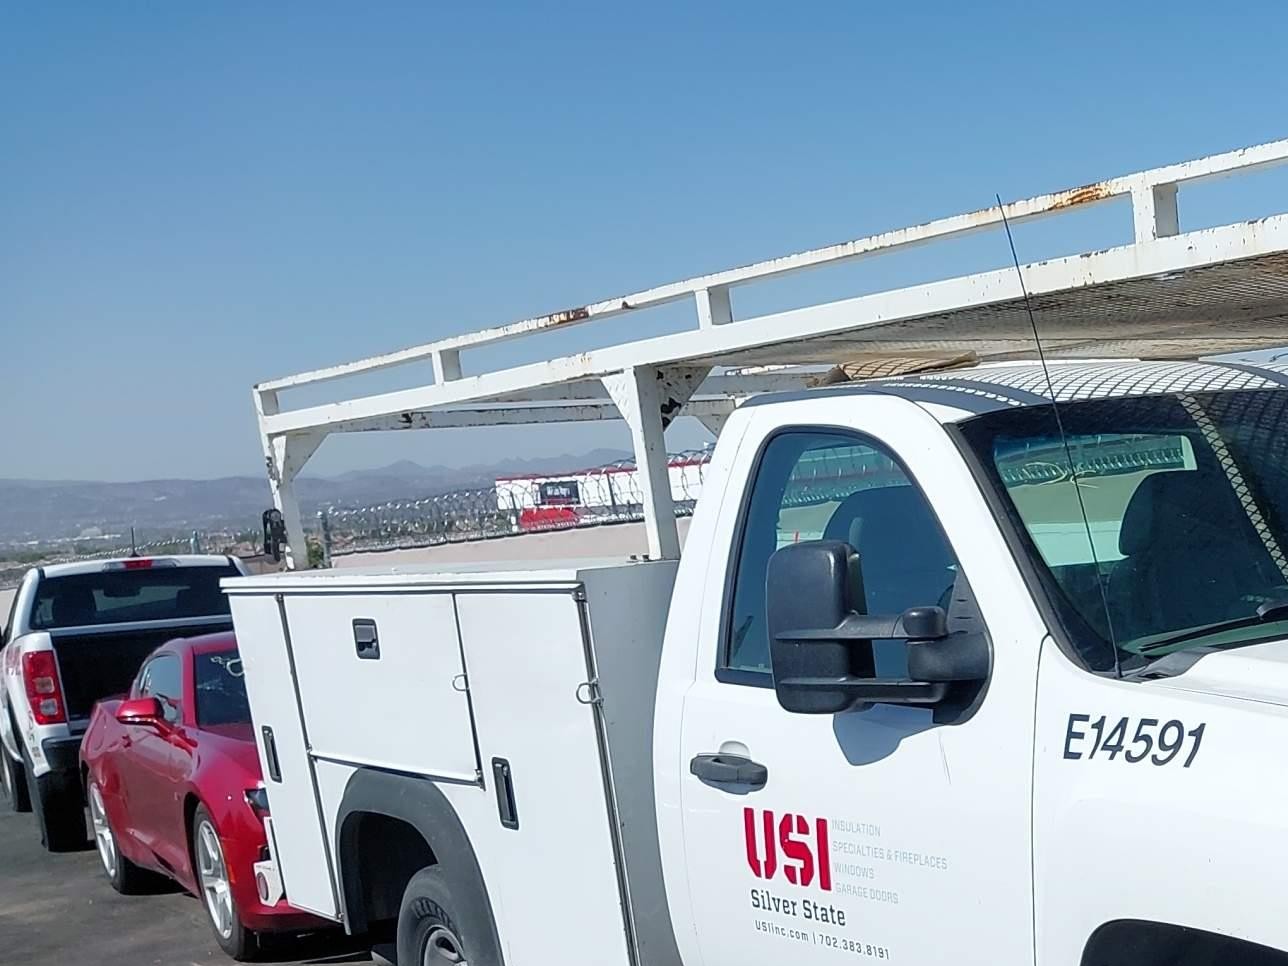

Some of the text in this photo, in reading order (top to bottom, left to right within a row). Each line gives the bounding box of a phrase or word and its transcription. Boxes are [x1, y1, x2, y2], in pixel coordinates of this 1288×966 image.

[1063, 713, 1206, 768] E14591
[832, 819, 881, 837] INSULATION
[743, 807, 832, 891] USI
[832, 841, 948, 870] SPECIALTIES & FIREPLACES
[834, 862, 875, 879] WINDOWS
[835, 882, 899, 904] GARAGE DOORS
[751, 889, 846, 926] Silver State
[819, 933, 890, 960] 702.383.8191
